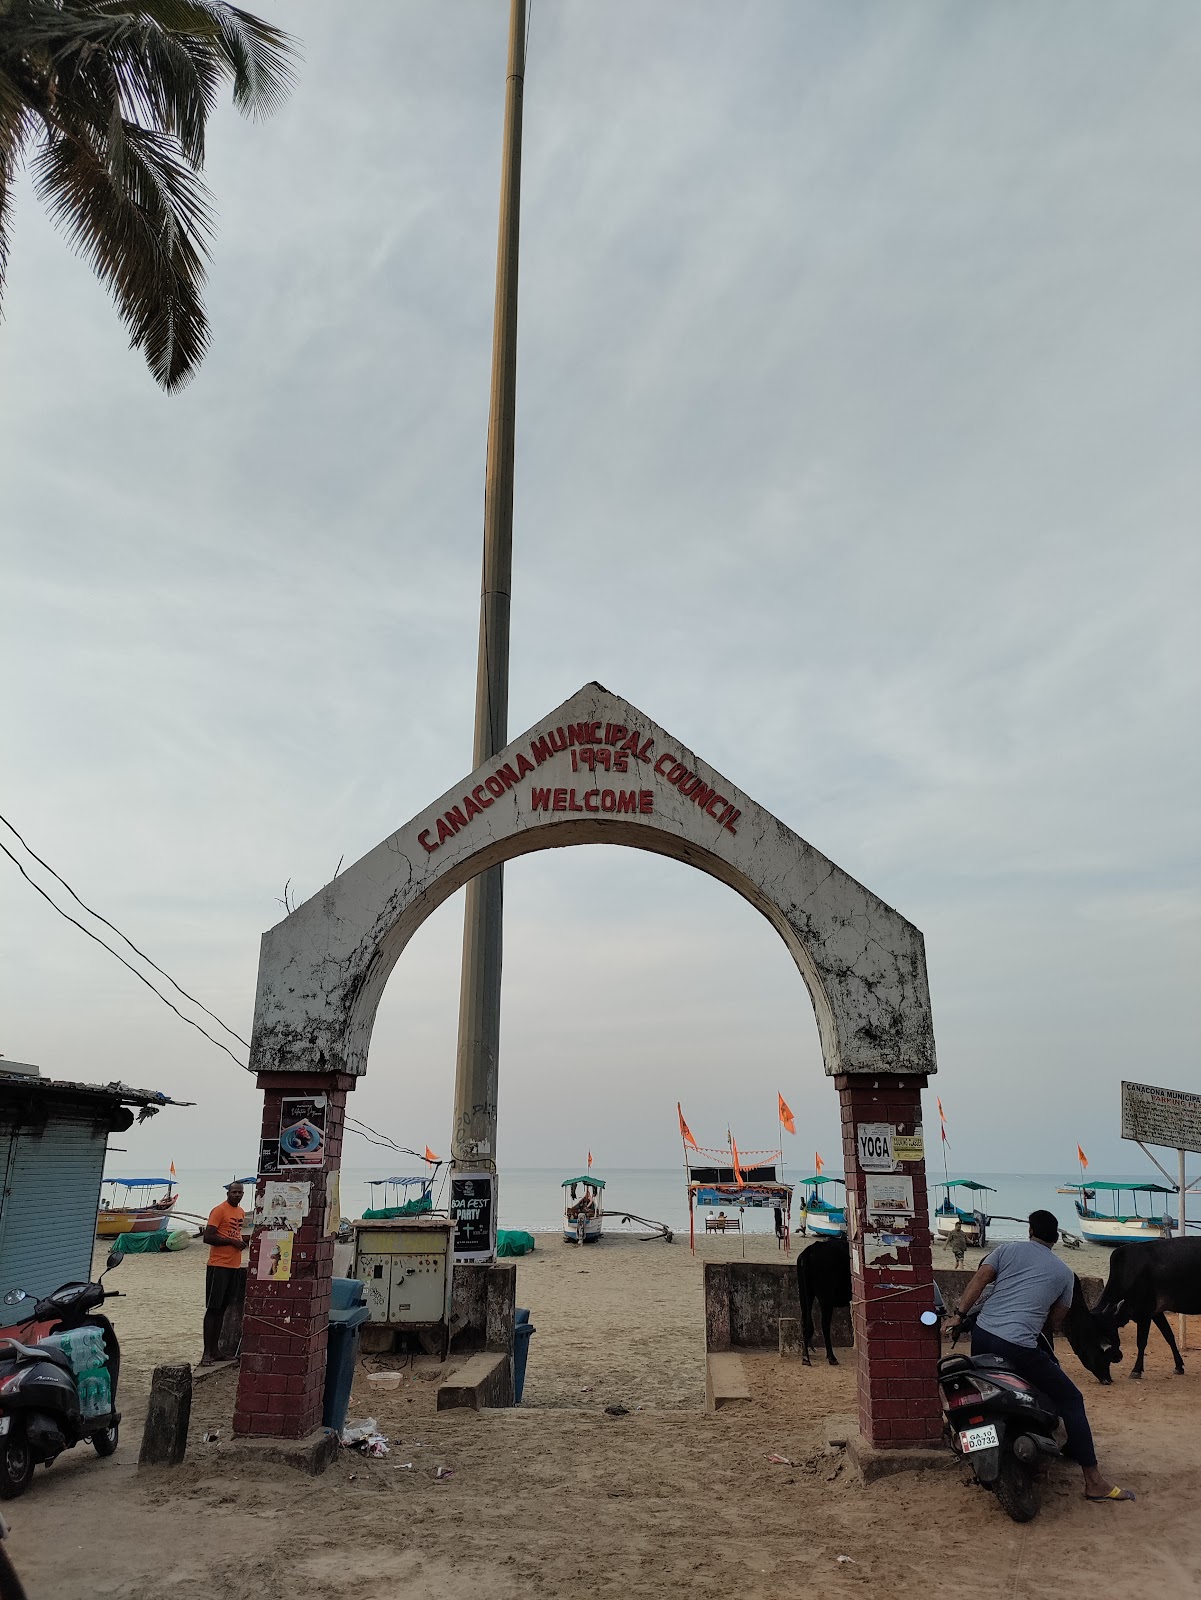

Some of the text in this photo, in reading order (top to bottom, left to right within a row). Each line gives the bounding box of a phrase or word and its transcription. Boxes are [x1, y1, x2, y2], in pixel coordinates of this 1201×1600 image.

[570, 748, 629, 773] 1995
[417, 721, 742, 852] CANACONA MUNICIPAL COUNCIL
[531, 787, 654, 814] WELCOME
[1126, 1083, 1165, 1096] CANACONA
[1151, 1094, 1186, 1107] PARKING
[860, 1136, 890, 1158] YOGA
[467, 1198, 490, 1208] FEST
[456, 1208, 480, 1221] PARTY
